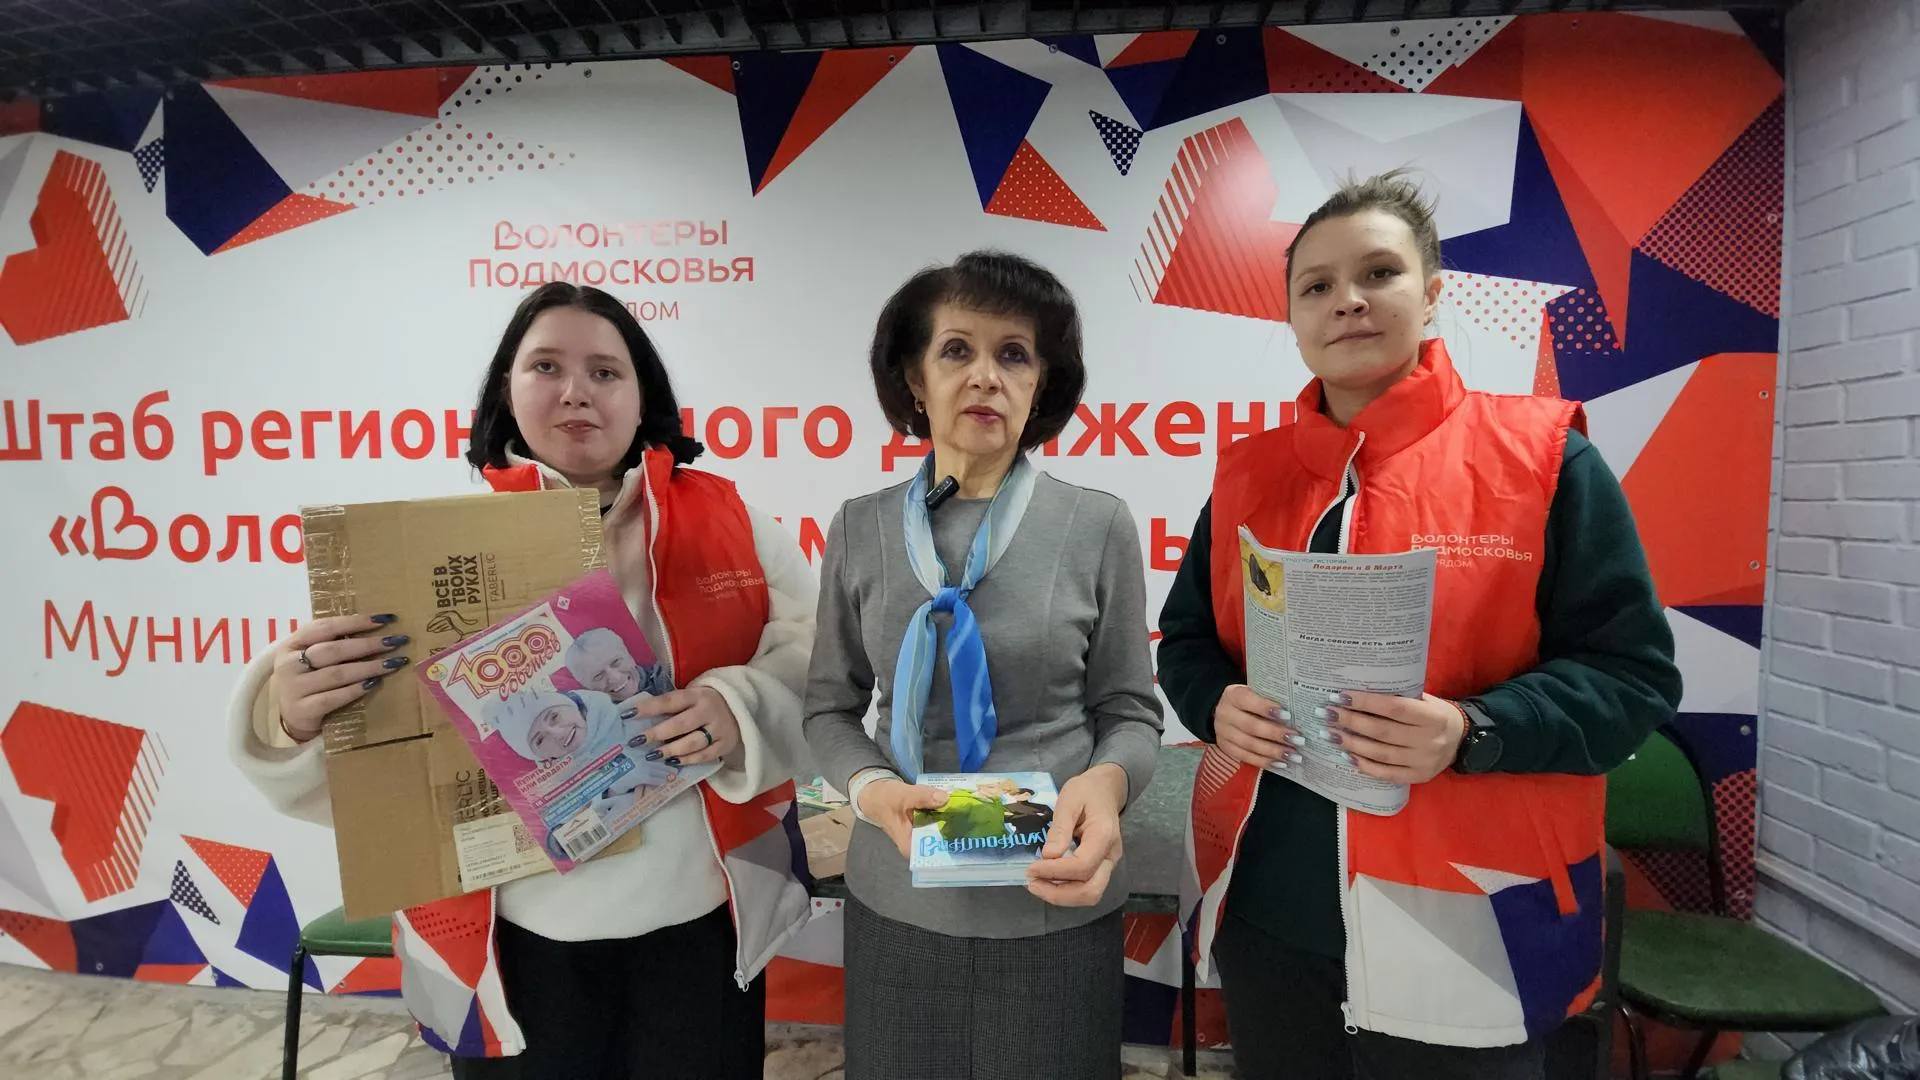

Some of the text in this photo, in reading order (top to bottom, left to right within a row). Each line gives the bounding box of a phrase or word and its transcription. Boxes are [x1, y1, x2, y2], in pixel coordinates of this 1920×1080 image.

[0, 389, 174, 461] Штаб
[1411, 534, 1514, 545] ВОЛОНТЕРЫ
[432, 566, 450, 608] ВСЁ В
[447, 554, 467, 607] ТВОИХ
[463, 555, 481, 604] РУКАХ
[484, 553, 499, 603] FABERLIC
[446, 624, 555, 699] 1000
